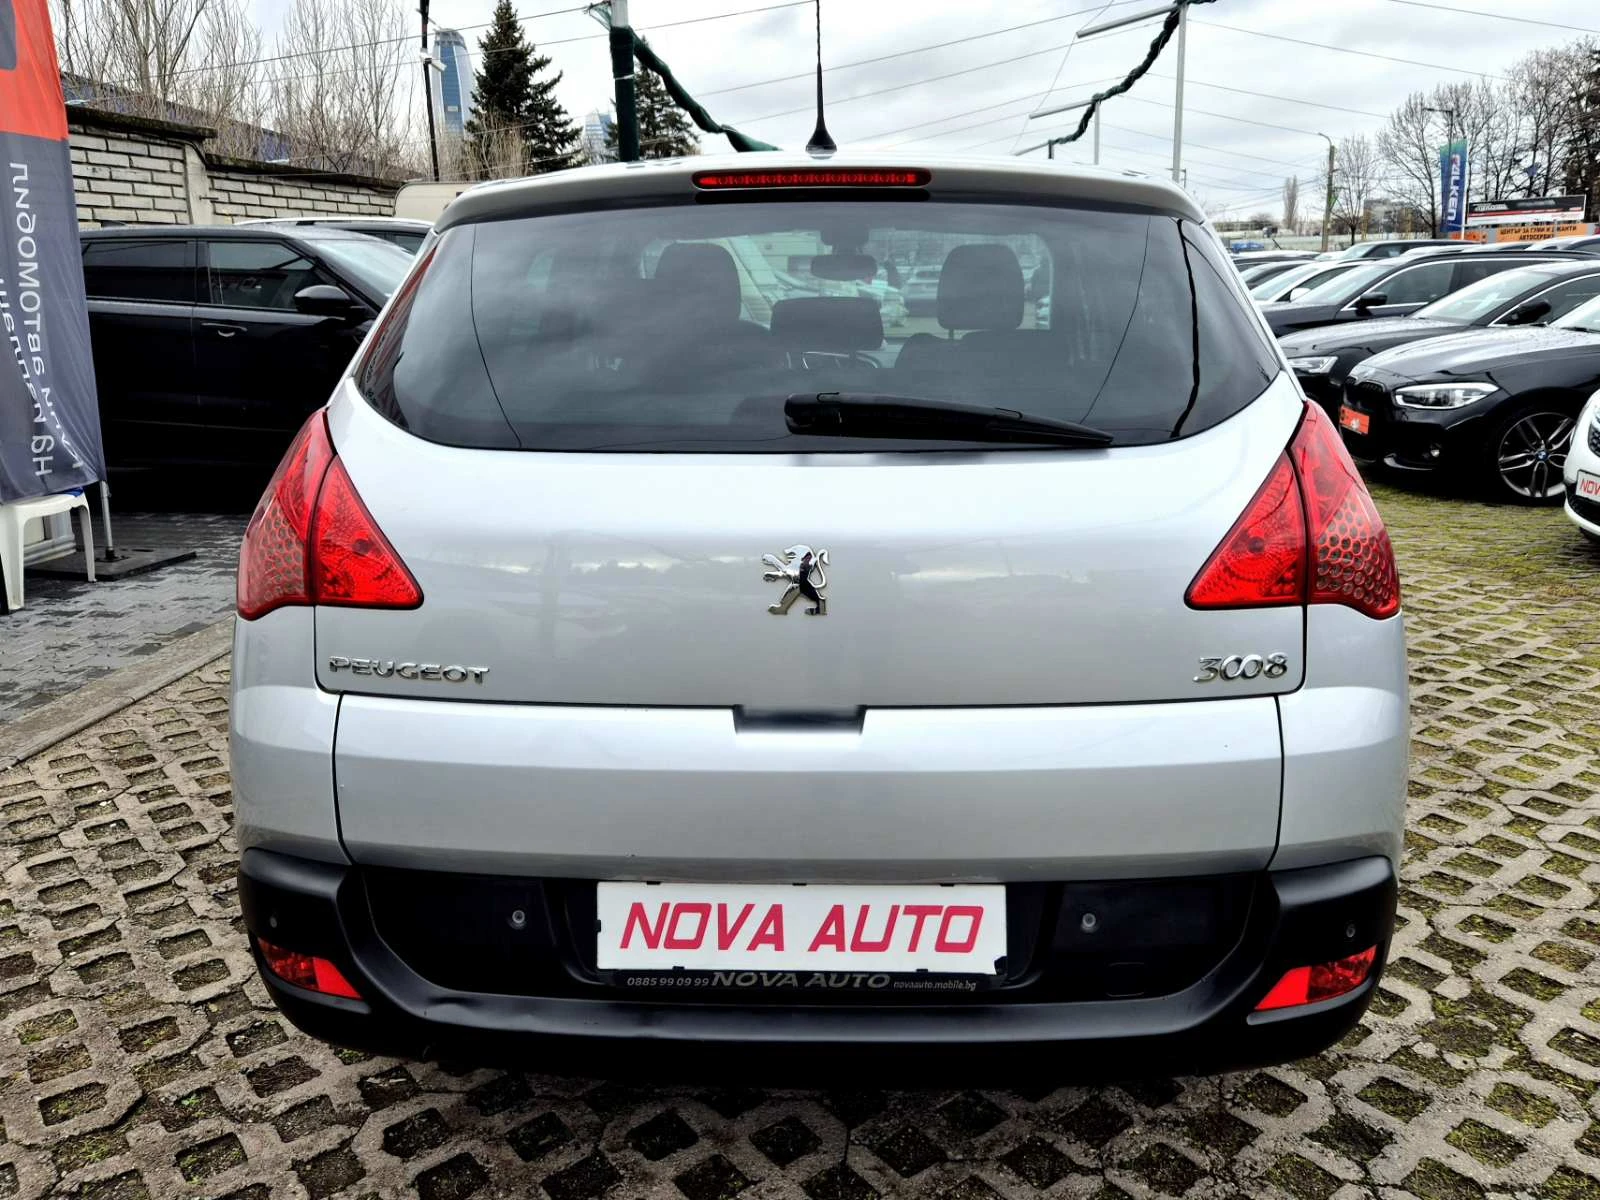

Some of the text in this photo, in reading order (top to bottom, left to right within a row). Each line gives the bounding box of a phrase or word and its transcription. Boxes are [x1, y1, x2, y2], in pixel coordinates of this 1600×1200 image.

[329, 655, 490, 684] PEUGEOT
[1192, 652, 1288, 682] 3008
[619, 902, 984, 954] NOVA AUTO
[627, 971, 977, 992] 0885 99 09 99 NOVA AUTO novaauto.mobile.bg
